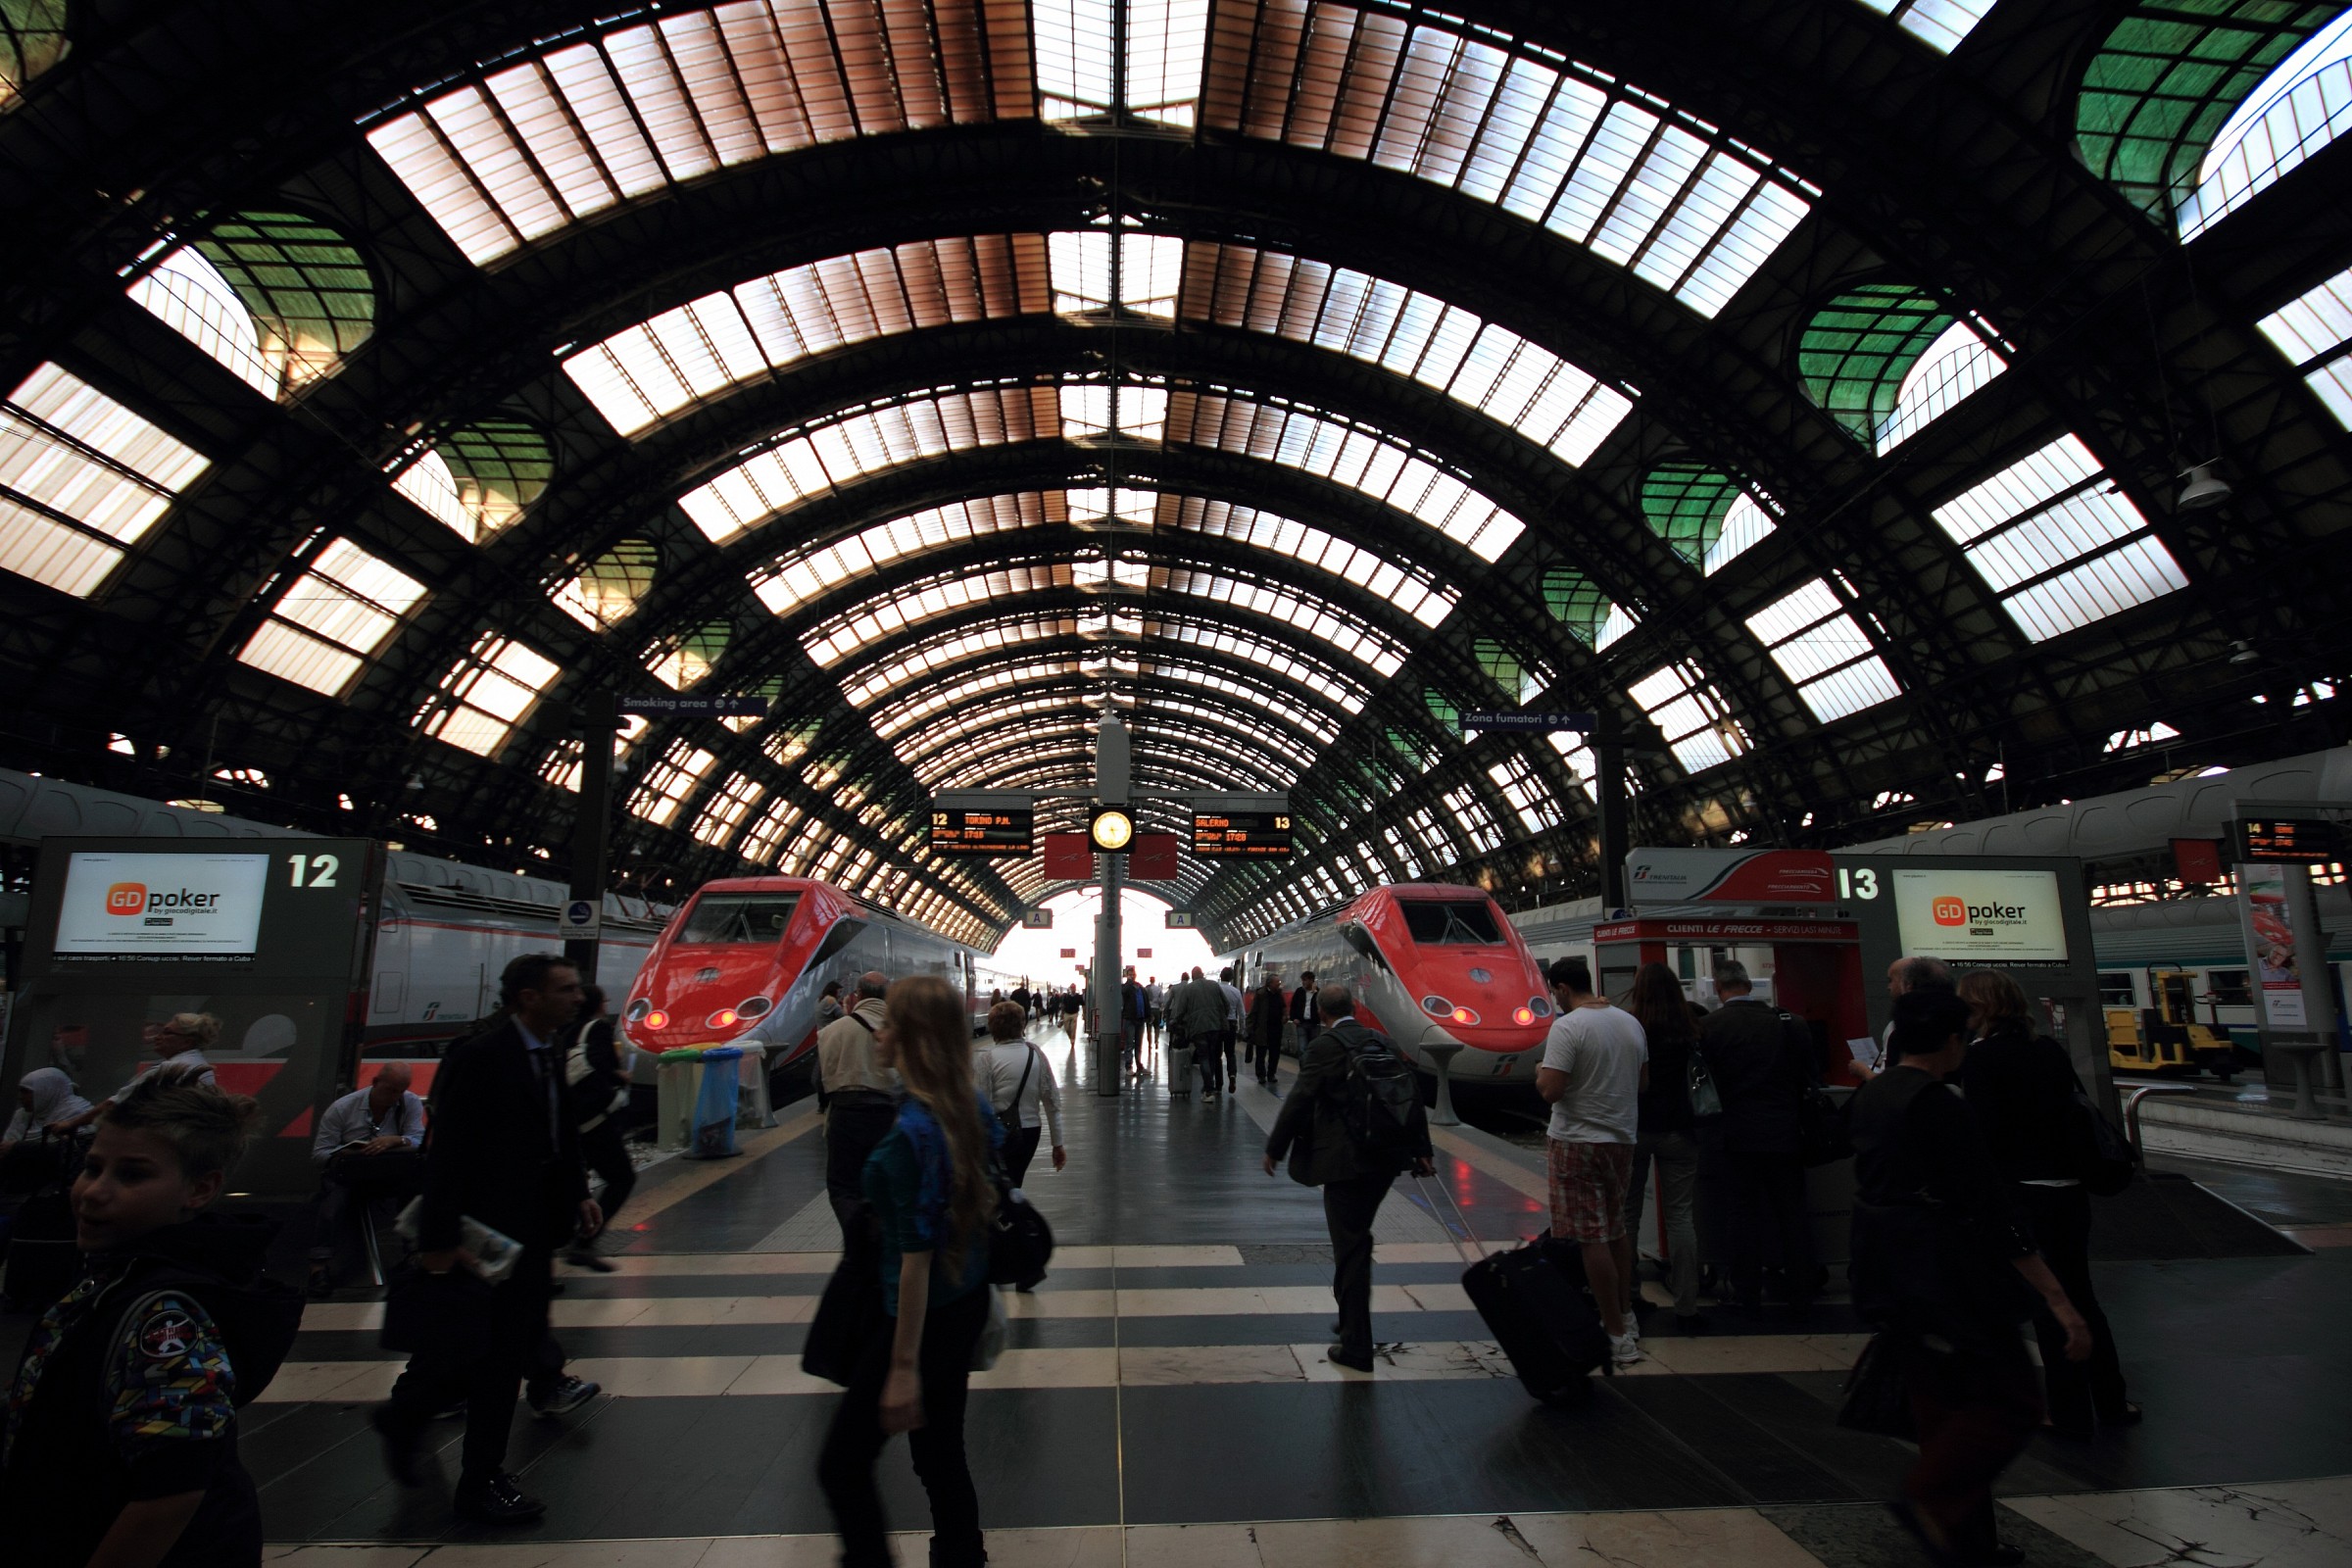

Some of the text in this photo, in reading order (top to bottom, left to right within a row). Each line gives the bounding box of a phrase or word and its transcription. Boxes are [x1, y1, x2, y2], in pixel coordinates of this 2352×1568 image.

[622, 698, 676, 710] Smoking
[1464, 713, 1543, 724] Zona fumatori
[932, 813, 948, 825] 12
[964, 816, 993, 825] TORINO
[1195, 818, 1229, 828] SALERNO
[1275, 816, 1291, 829] 13
[2247, 822, 2262, 834] 14
[288, 854, 340, 888] 12
[1839, 868, 1879, 900] 13
[110, 891, 141, 907] GD
[147, 887, 220, 913] poker
[1936, 904, 1962, 919] GD
[1968, 902, 2026, 923] poker
[1033, 913, 1041, 923] A
[1177, 914, 1184, 924] A
[1618, 925, 1636, 935] FRECCE
[1667, 924, 1703, 933] CLIENTI
[1706, 924, 1720, 933] LE
[1723, 924, 1763, 934] FRECCE
[1817, 926, 1841, 935] MINUTE
